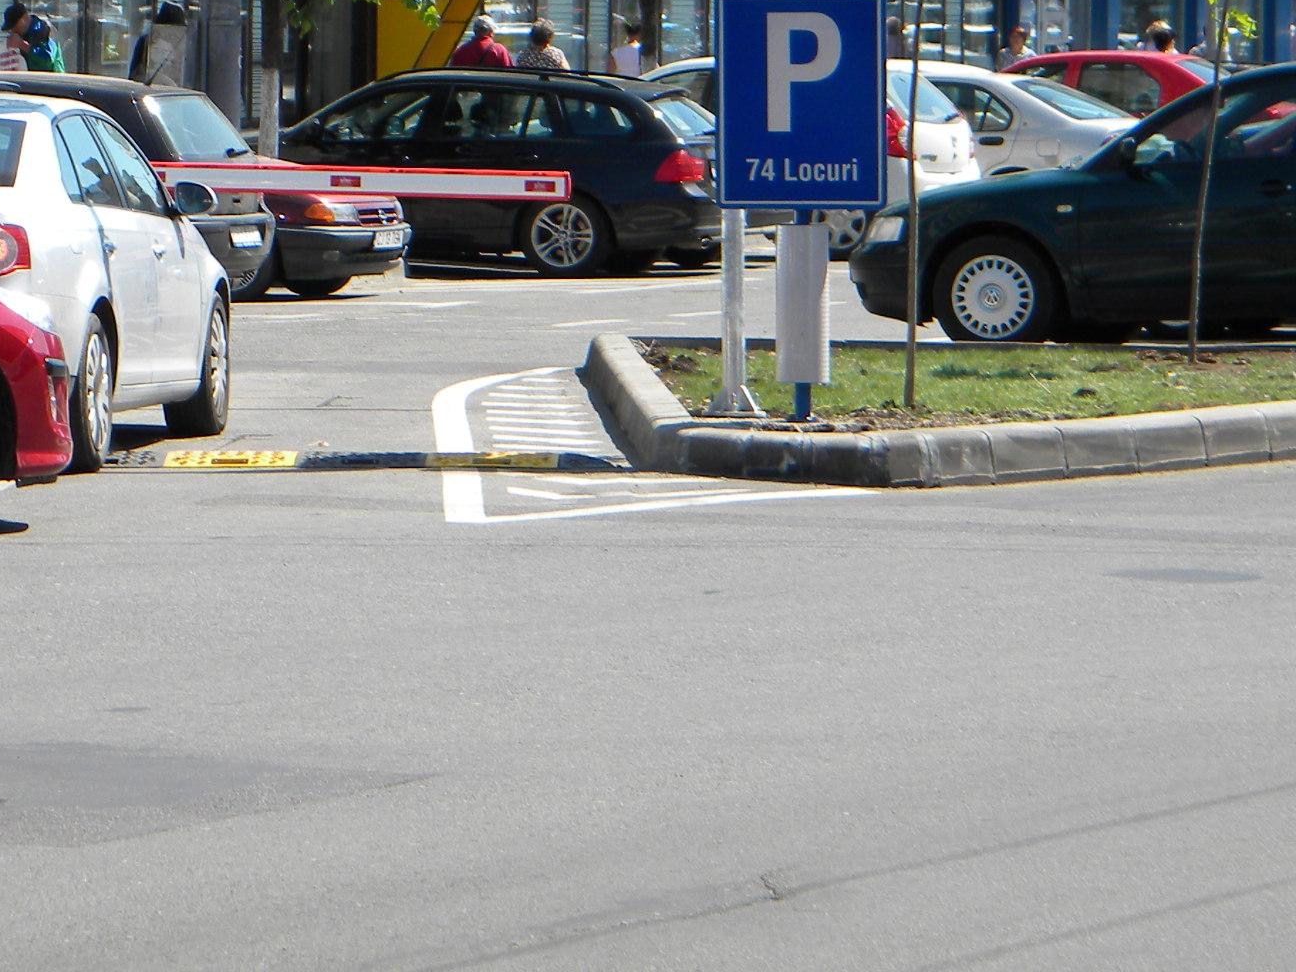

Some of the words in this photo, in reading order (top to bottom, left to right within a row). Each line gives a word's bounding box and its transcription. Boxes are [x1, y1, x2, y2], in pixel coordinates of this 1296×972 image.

[765, 11, 842, 133] P
[745, 157, 776, 182] 74
[784, 157, 858, 183] Locuri
